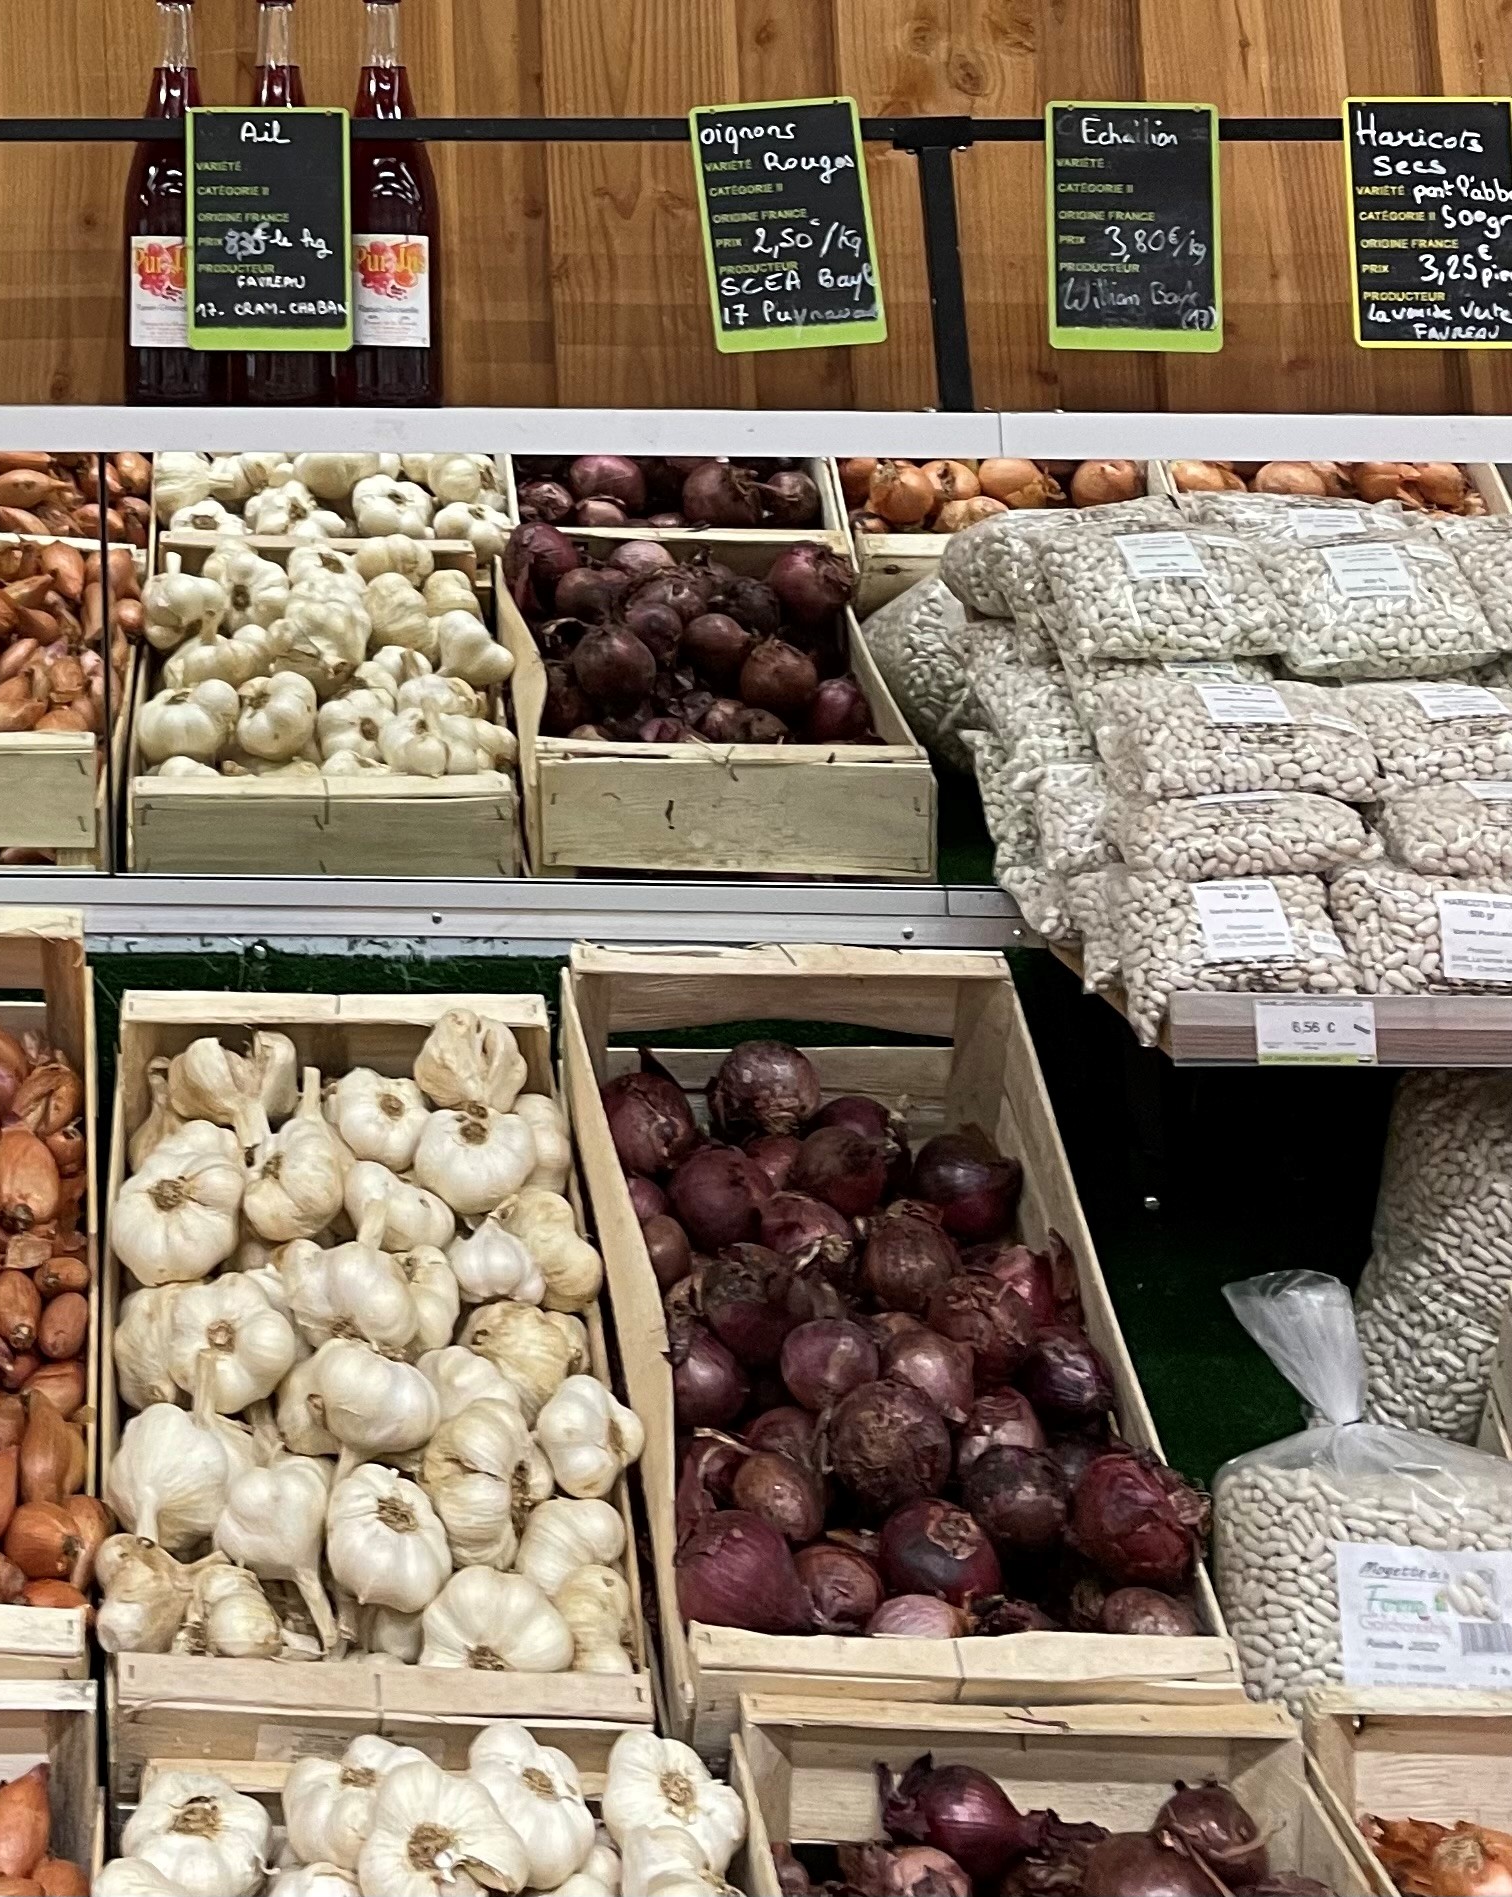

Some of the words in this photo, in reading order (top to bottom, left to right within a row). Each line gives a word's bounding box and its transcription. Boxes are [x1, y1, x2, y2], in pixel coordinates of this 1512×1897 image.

[240, 121, 291, 144] Ail
[1356, 110, 1484, 152] Haricots
[1373, 155, 1446, 176] Secs
[245, 212, 289, 222] FRANCE
[761, 208, 807, 220] FRANCE
[1108, 211, 1155, 221] FRANCE
[1360, 238, 1408, 249] ORIGINE
[1411, 238, 1459, 249] FRANCE
[198, 264, 275, 274] PRODUCTEUR
[719, 261, 799, 275] PRODUCTEUR
[1059, 262, 1140, 273] PRODUCTEUR
[720, 270, 801, 296] SCEA
[1363, 291, 1445, 301] PRODUCTEUR
[723, 304, 749, 325] 17
[1413, 323, 1500, 340] FAVREAU
